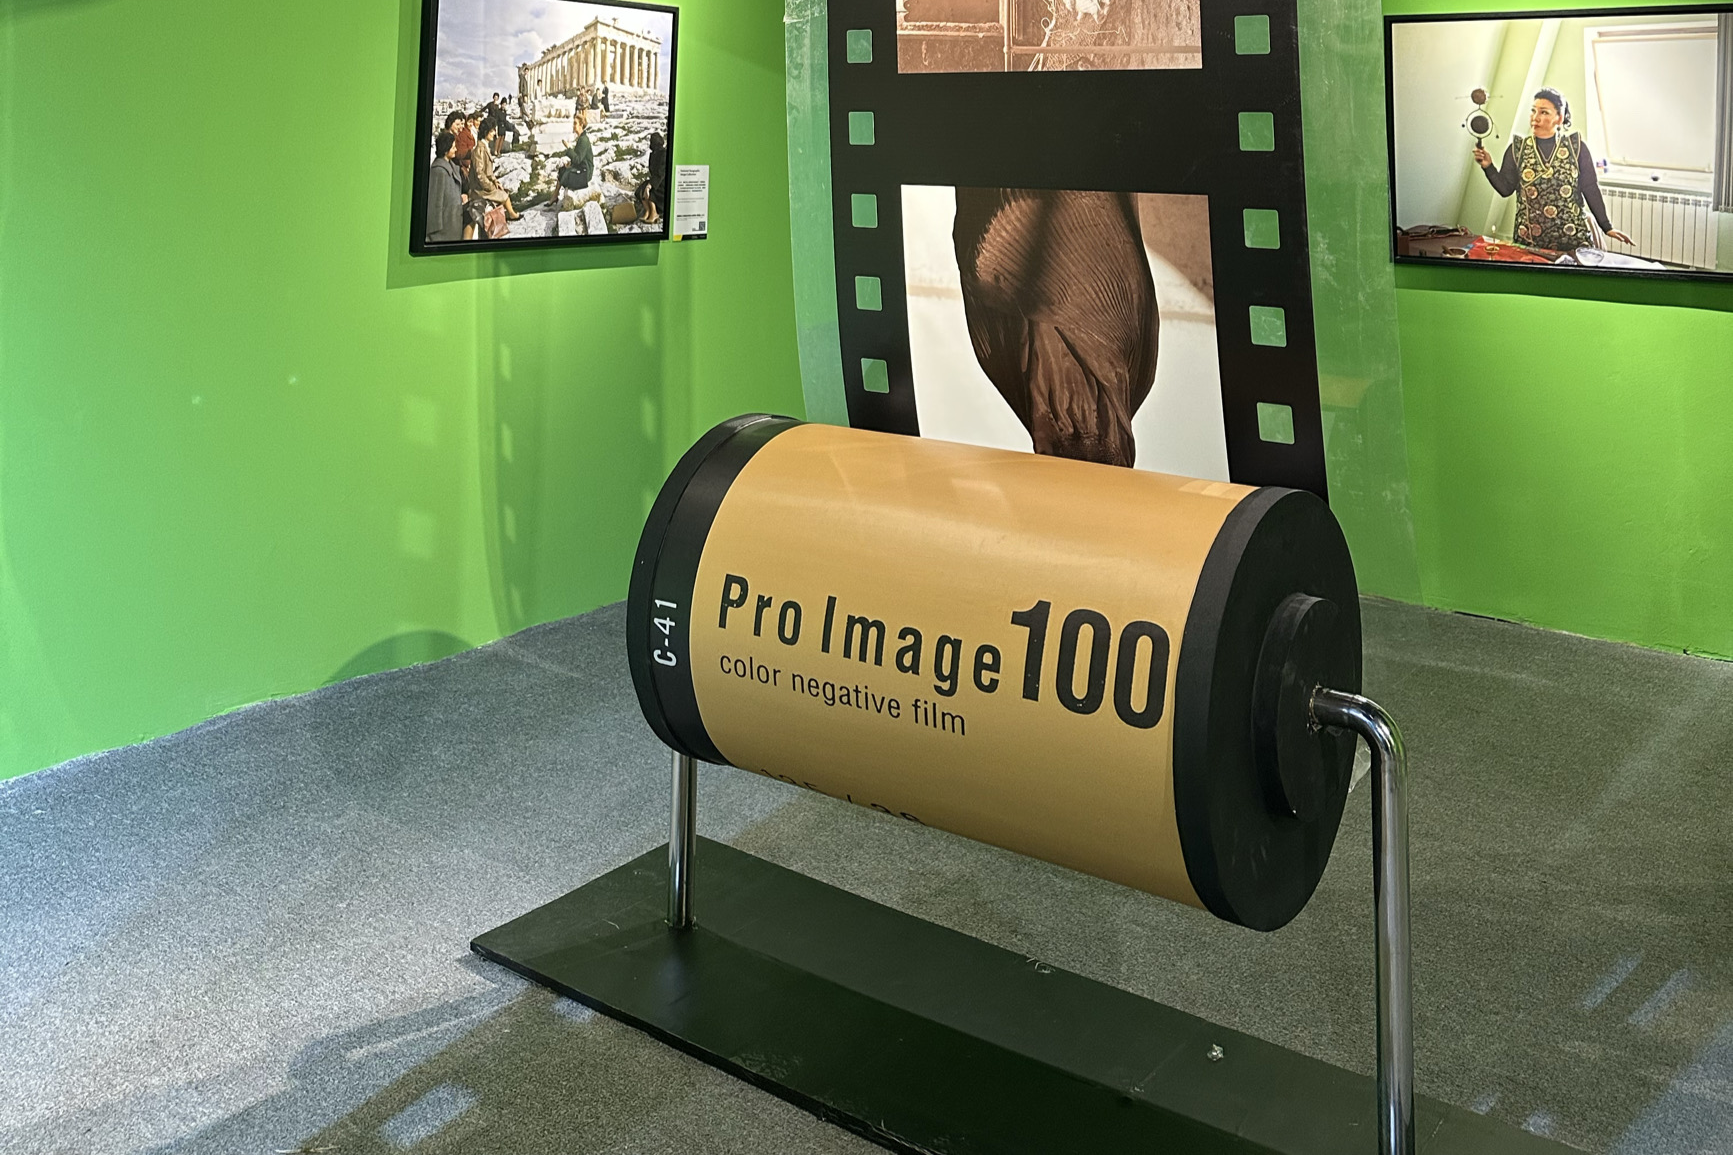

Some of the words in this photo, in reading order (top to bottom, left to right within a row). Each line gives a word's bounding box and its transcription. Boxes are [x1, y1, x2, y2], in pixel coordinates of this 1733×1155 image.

[653, 599, 677, 667] C-41
[718, 573, 802, 646] Pro
[821, 595, 1002, 698] Image
[1010, 600, 1170, 730] 100
[720, 655, 782, 687] color
[791, 672, 901, 719] negative
[911, 698, 966, 736] film
